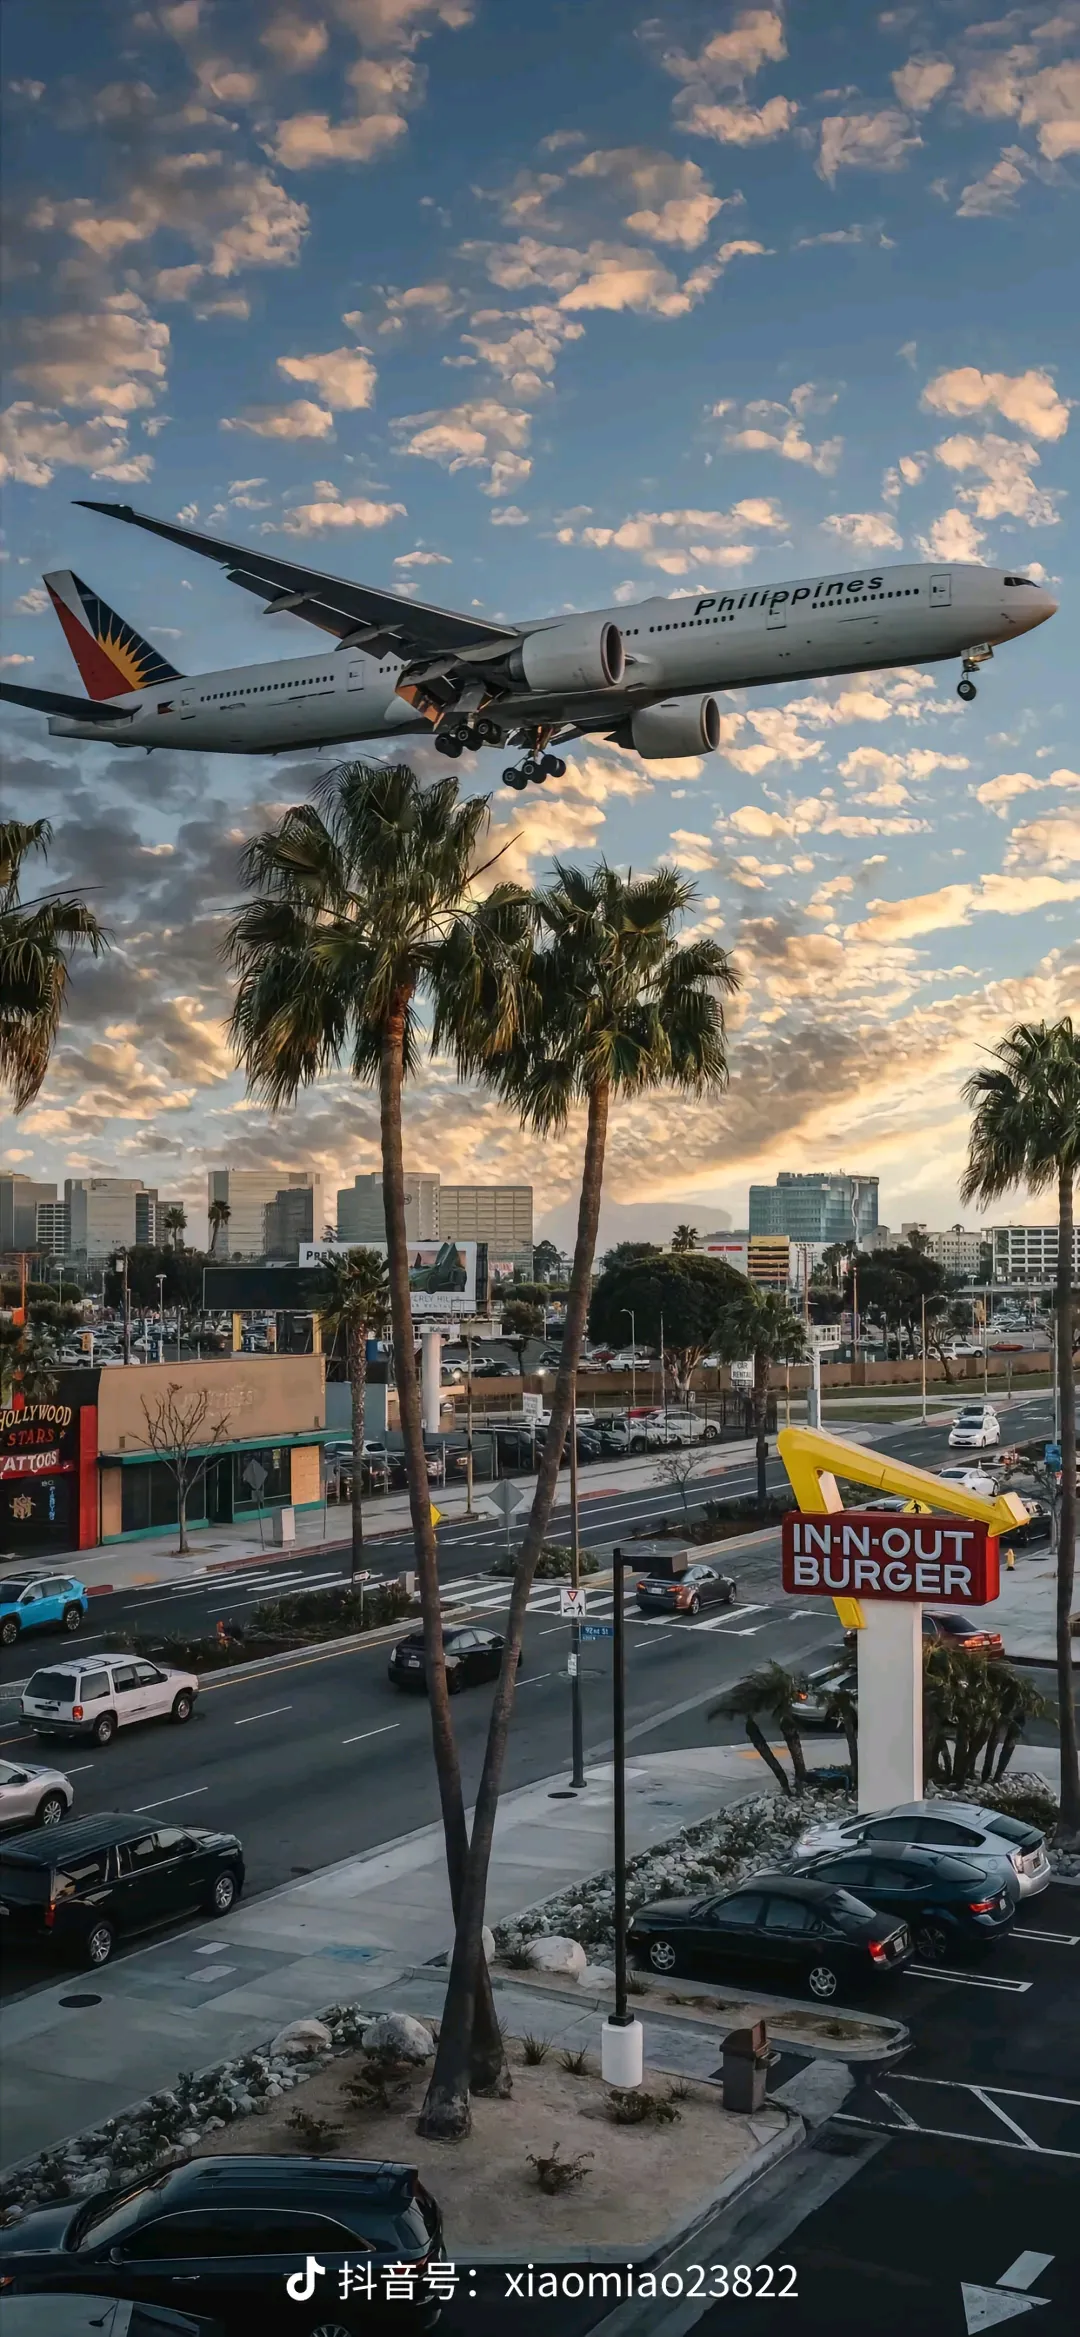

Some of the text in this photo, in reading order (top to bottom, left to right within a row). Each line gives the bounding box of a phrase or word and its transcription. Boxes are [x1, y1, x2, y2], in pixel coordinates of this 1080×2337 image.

[694, 576, 884, 616] Philippines
[737, 1361, 749, 1370] CAR
[0, 1404, 72, 1431] HOLLYWOOD
[7, 1428, 55, 1447] STARS
[793, 1523, 975, 1562] IN-N-OUT
[793, 1555, 972, 1596] BURGER
[585, 1627, 600, 1635] 92nd
